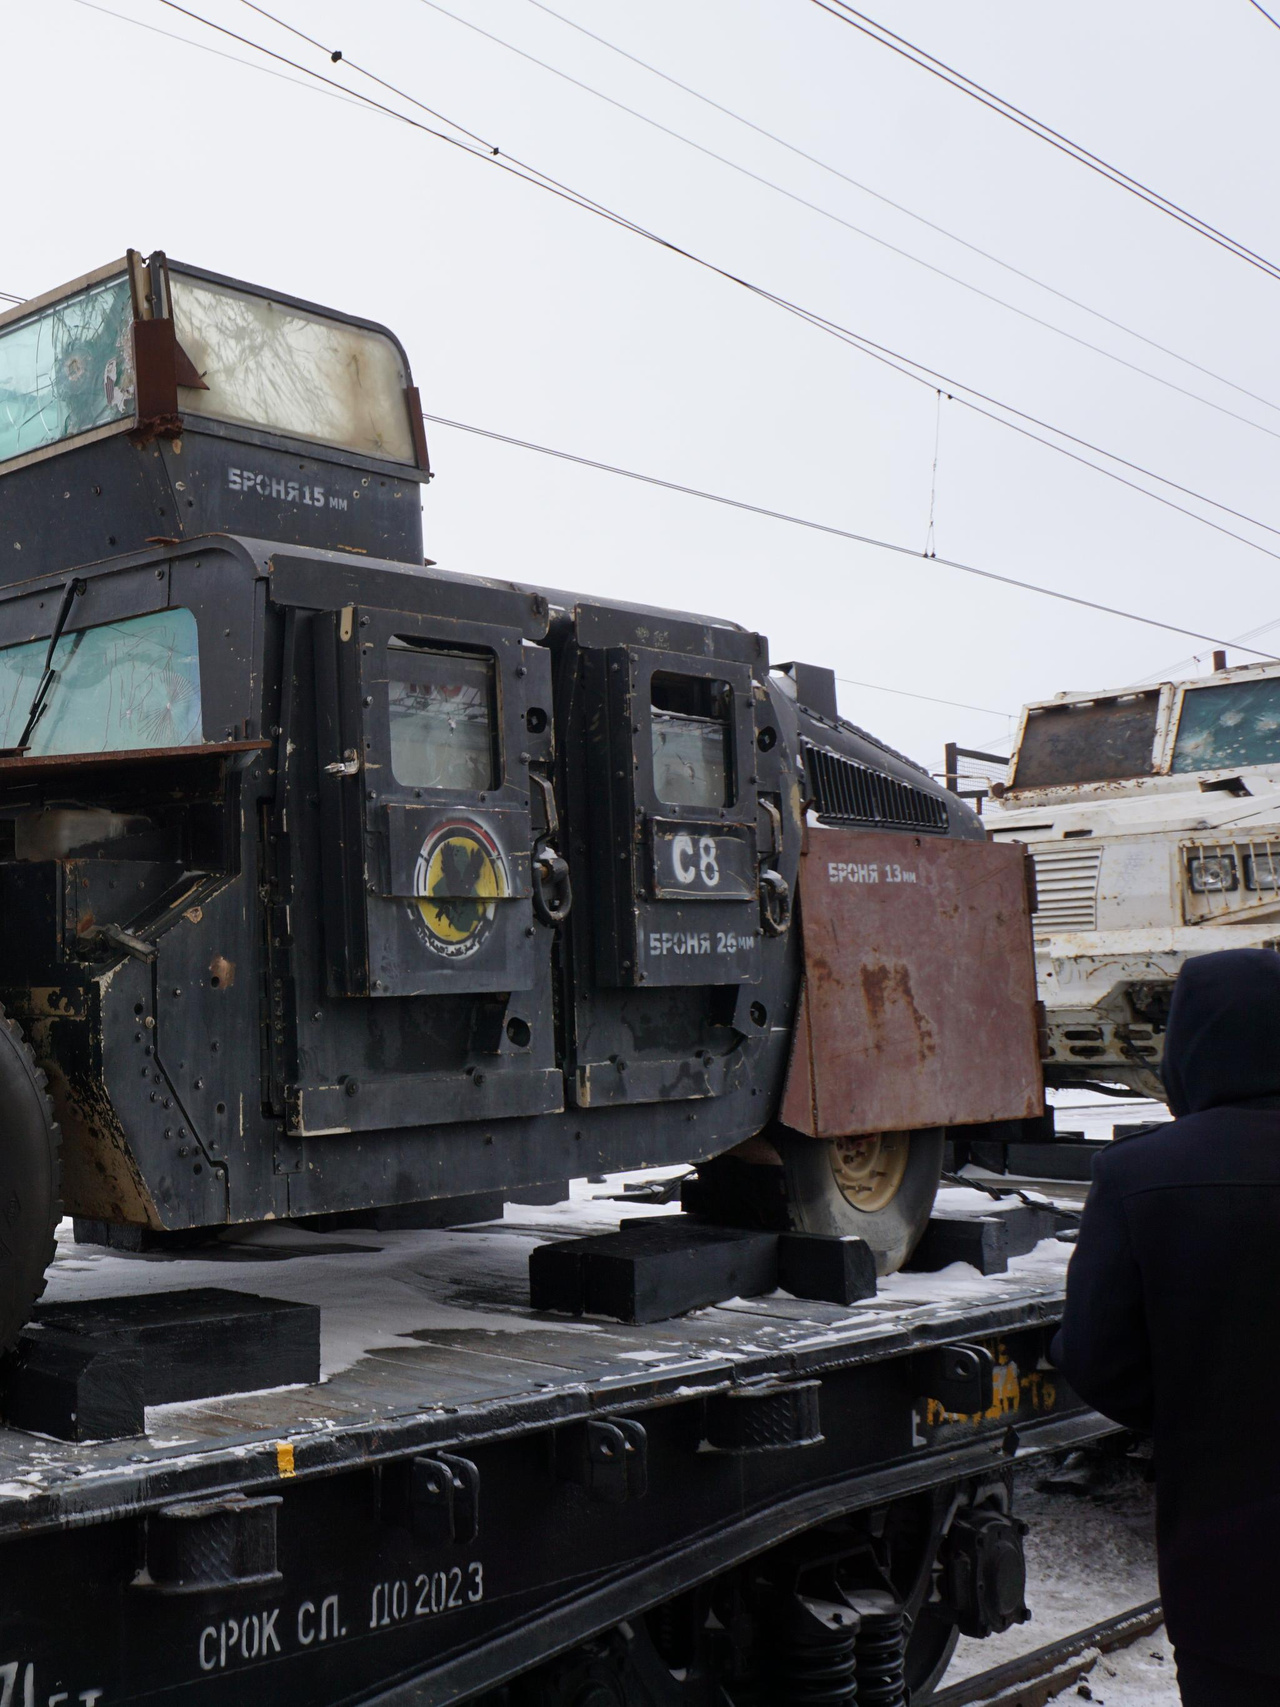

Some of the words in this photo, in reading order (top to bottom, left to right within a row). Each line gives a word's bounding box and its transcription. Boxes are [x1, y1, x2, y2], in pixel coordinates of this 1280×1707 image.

[228, 467, 300, 503] БРОНЯ
[303, 485, 325, 507] 15
[828, 862, 879, 884] БРОНЯ
[885, 864, 902, 883] 13
[649, 932, 711, 956] БРОНЯ
[717, 931, 737, 954] 26
[198, 1608, 282, 1671] СРОК
[414, 1561, 484, 1615] 2023
